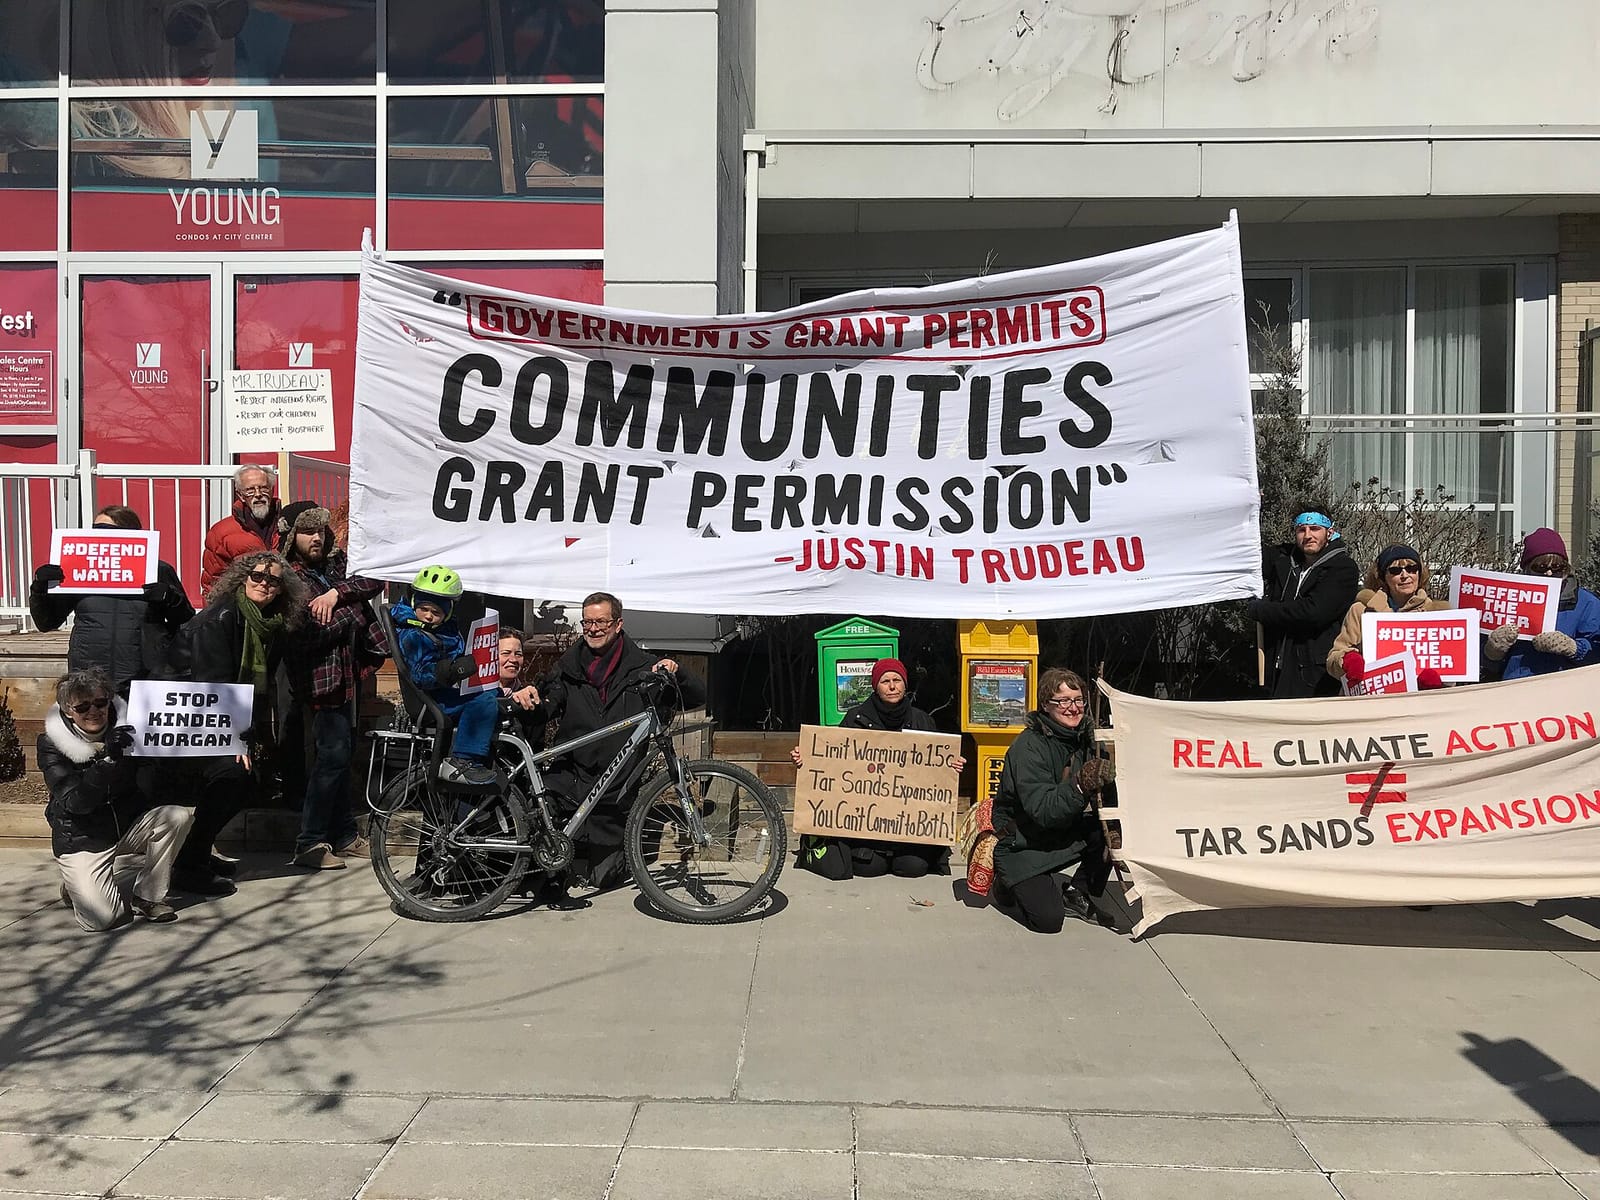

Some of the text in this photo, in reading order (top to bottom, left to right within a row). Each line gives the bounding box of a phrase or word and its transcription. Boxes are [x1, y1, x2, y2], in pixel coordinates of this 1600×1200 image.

[168, 187, 280, 225] YOUNG
[175, 233, 273, 242] CONDOS AT CITY CENTRE
[0, 308, 34, 330] est
[784, 315, 910, 348] GRANT
[923, 295, 1096, 349] PERMITS
[9, 364, 29, 372] Hours
[17, 355, 44, 365] Centre
[129, 369, 169, 384] YOUNG
[438, 353, 1113, 463] COMMUNITIES
[271, 426, 283, 434] THE
[431, 456, 664, 526] GRANT
[62, 543, 146, 557] #DEFEND
[86, 556, 121, 569] THE
[952, 536, 1145, 584] TRUDEAU
[73, 569, 134, 582] WATER
[1460, 581, 1546, 605] #DEFEND
[1483, 597, 1517, 615] THE
[1479, 609, 1530, 629] ATER
[845, 625, 870, 635] FREE
[1377, 626, 1466, 642] #DEFEND
[1403, 641, 1440, 655] THE
[165, 692, 219, 708] STOP
[148, 712, 231, 729] KINDER
[143, 732, 232, 747] MORGAN
[1172, 711, 1597, 769] REAL CLIMATE ACTION
[811, 733, 851, 759] Limit
[854, 739, 908, 768] Warming
[910, 748, 923, 766] to
[587, 737, 634, 804] MARIN
[867, 762, 886, 775] OR
[809, 769, 953, 805] Tar Sands Expansion
[808, 799, 955, 842] You Can't Commit to Both!
[1175, 789, 1600, 858] TAR SANDS EXPANSION
